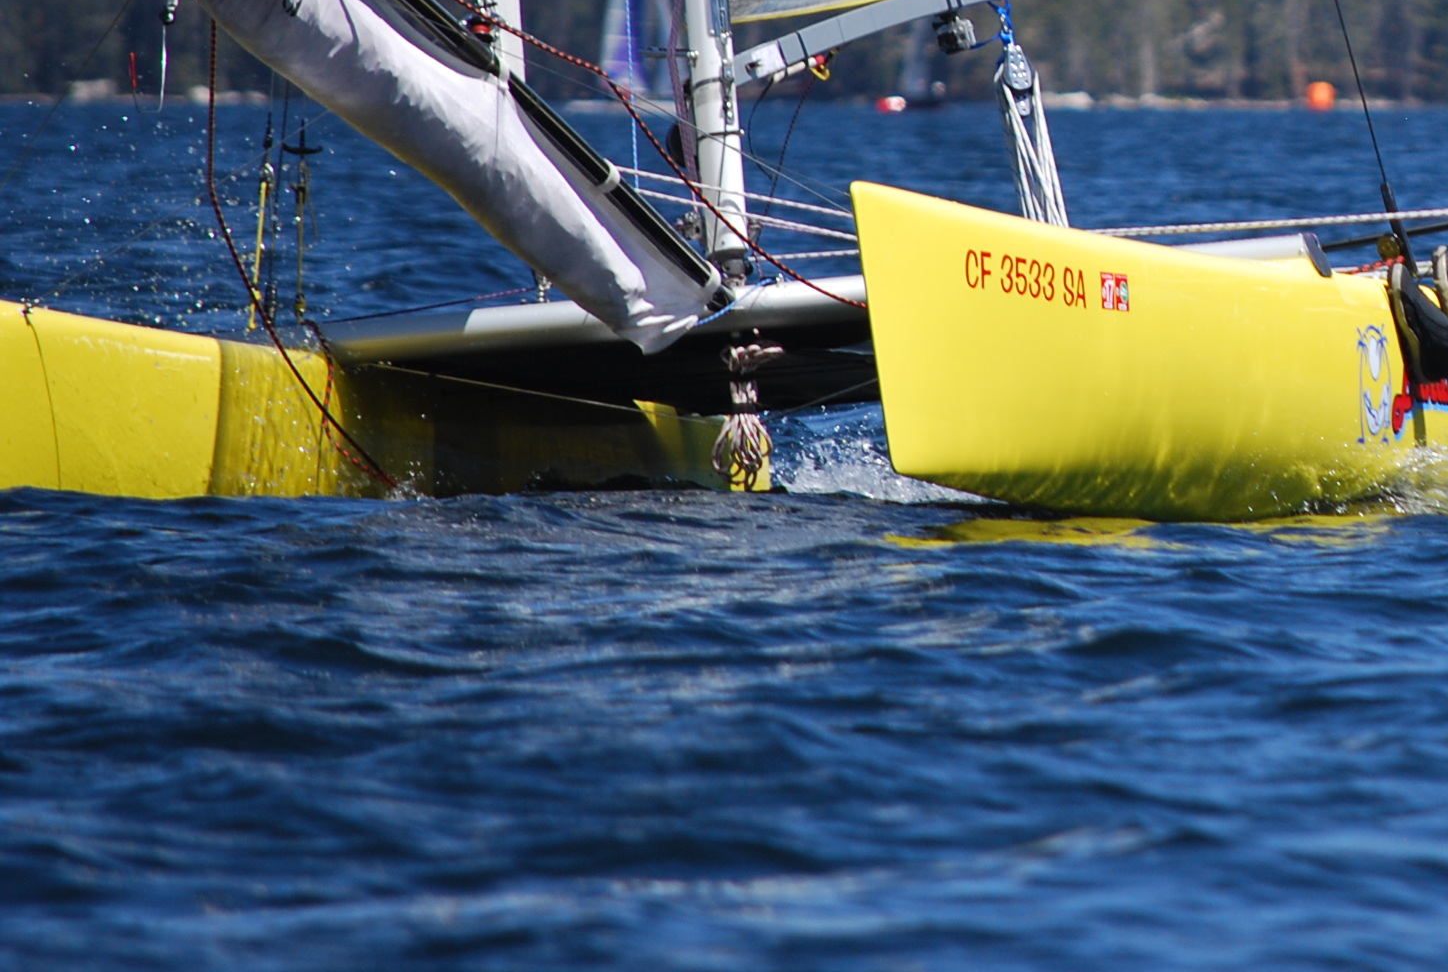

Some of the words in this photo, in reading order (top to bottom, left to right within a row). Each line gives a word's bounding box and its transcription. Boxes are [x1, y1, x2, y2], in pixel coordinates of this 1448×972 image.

[966, 249, 992, 289] CF
[1000, 254, 1055, 301] 3533
[1063, 266, 1087, 309] SA
